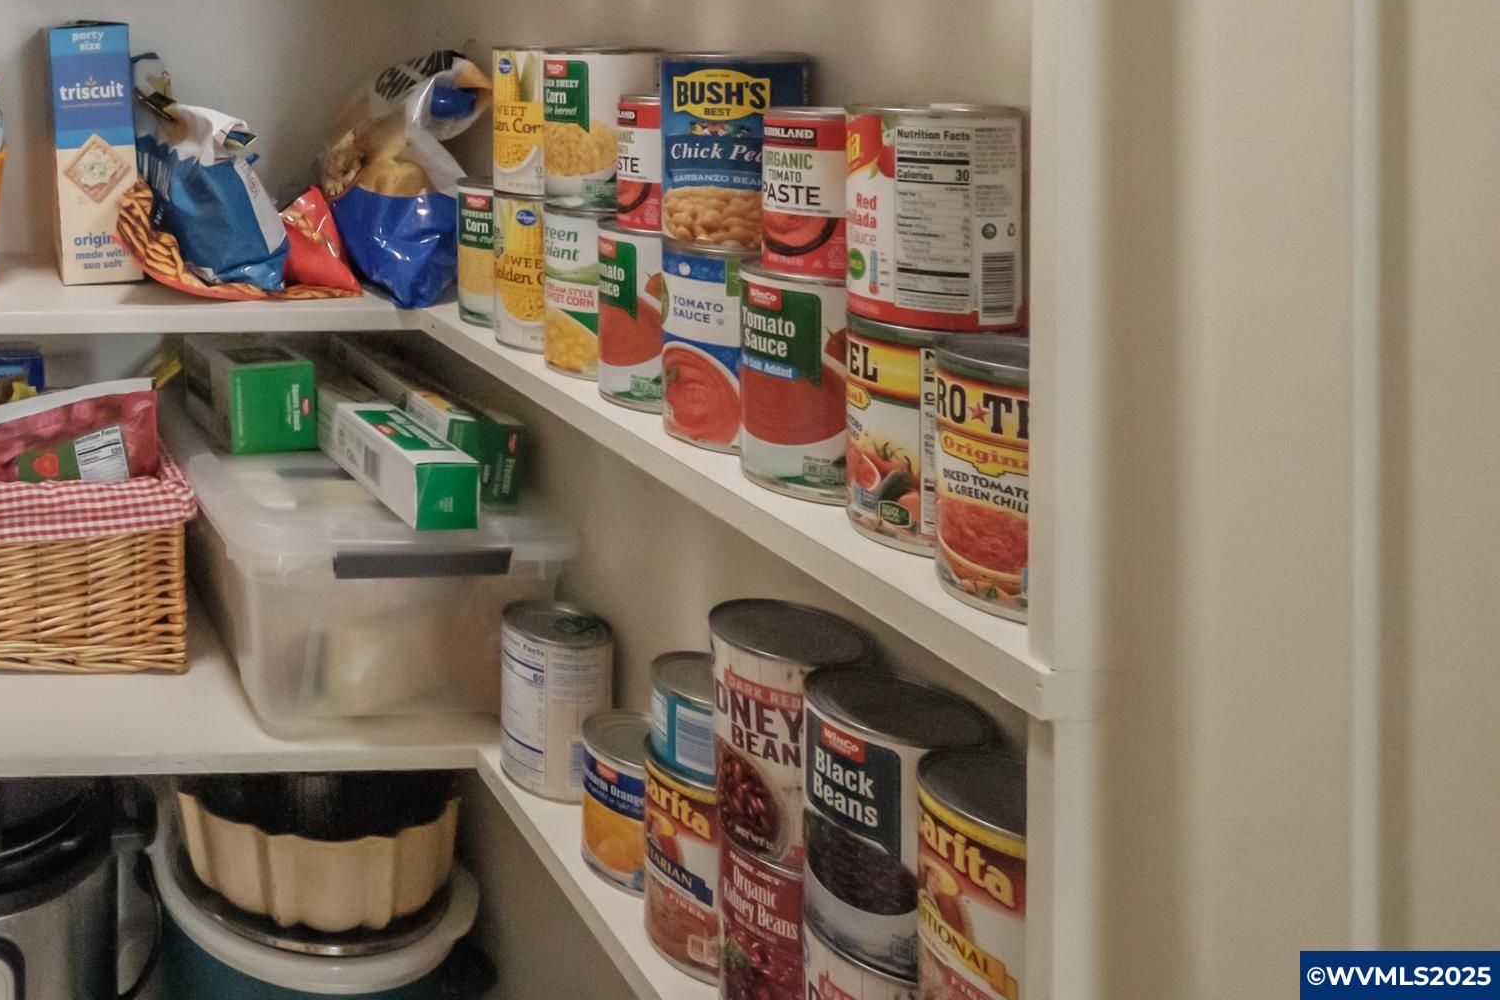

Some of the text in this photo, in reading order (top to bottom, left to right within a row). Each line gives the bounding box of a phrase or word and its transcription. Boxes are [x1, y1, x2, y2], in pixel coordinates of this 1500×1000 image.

[72, 30, 105, 43] party
[79, 41, 102, 52] size
[59, 81, 125, 101] triscuit
[555, 79, 580, 88] SWEET
[546, 90, 567, 104] Corn
[676, 80, 766, 110] BUSH'S
[554, 105, 578, 116] kernel
[703, 107, 732, 117] BEST
[896, 128, 971, 142] Nutrition Facts
[671, 142, 763, 163] Chick Pea
[617, 157, 640, 175] STE
[897, 168, 970, 182] Calories 30
[673, 173, 730, 183] GARBANZO
[768, 169, 803, 183] TOMATO
[762, 182, 821, 207] PASTE
[855, 192, 878, 211] Red
[461, 210, 494, 219] SUPERSWEE
[465, 218, 489, 233] Corn
[545, 226, 579, 244] reen
[75, 250, 103, 260] made
[83, 258, 123, 270] sea salt
[503, 255, 544, 270] SWEE
[599, 263, 626, 281] mato
[568, 286, 595, 298] STYLE
[749, 286, 778, 302] WinCo
[566, 295, 595, 309] CORN
[672, 294, 725, 314] TOMATO
[672, 306, 711, 325] SAUCE
[742, 306, 797, 338] Tomato
[744, 328, 788, 358] Sauce
[763, 360, 793, 379] Added
[943, 434, 1029, 471] Origina
[943, 467, 970, 483] DICED
[954, 483, 991, 502] GREEN
[728, 673, 800, 709] DARK RED
[731, 722, 802, 769] BEAN
[824, 727, 860, 753] WinCo
[814, 745, 875, 800] Black
[812, 769, 879, 828] Beans
[732, 865, 778, 910] Organic
[722, 876, 755, 923] Kidney
[757, 904, 799, 940] Beans
